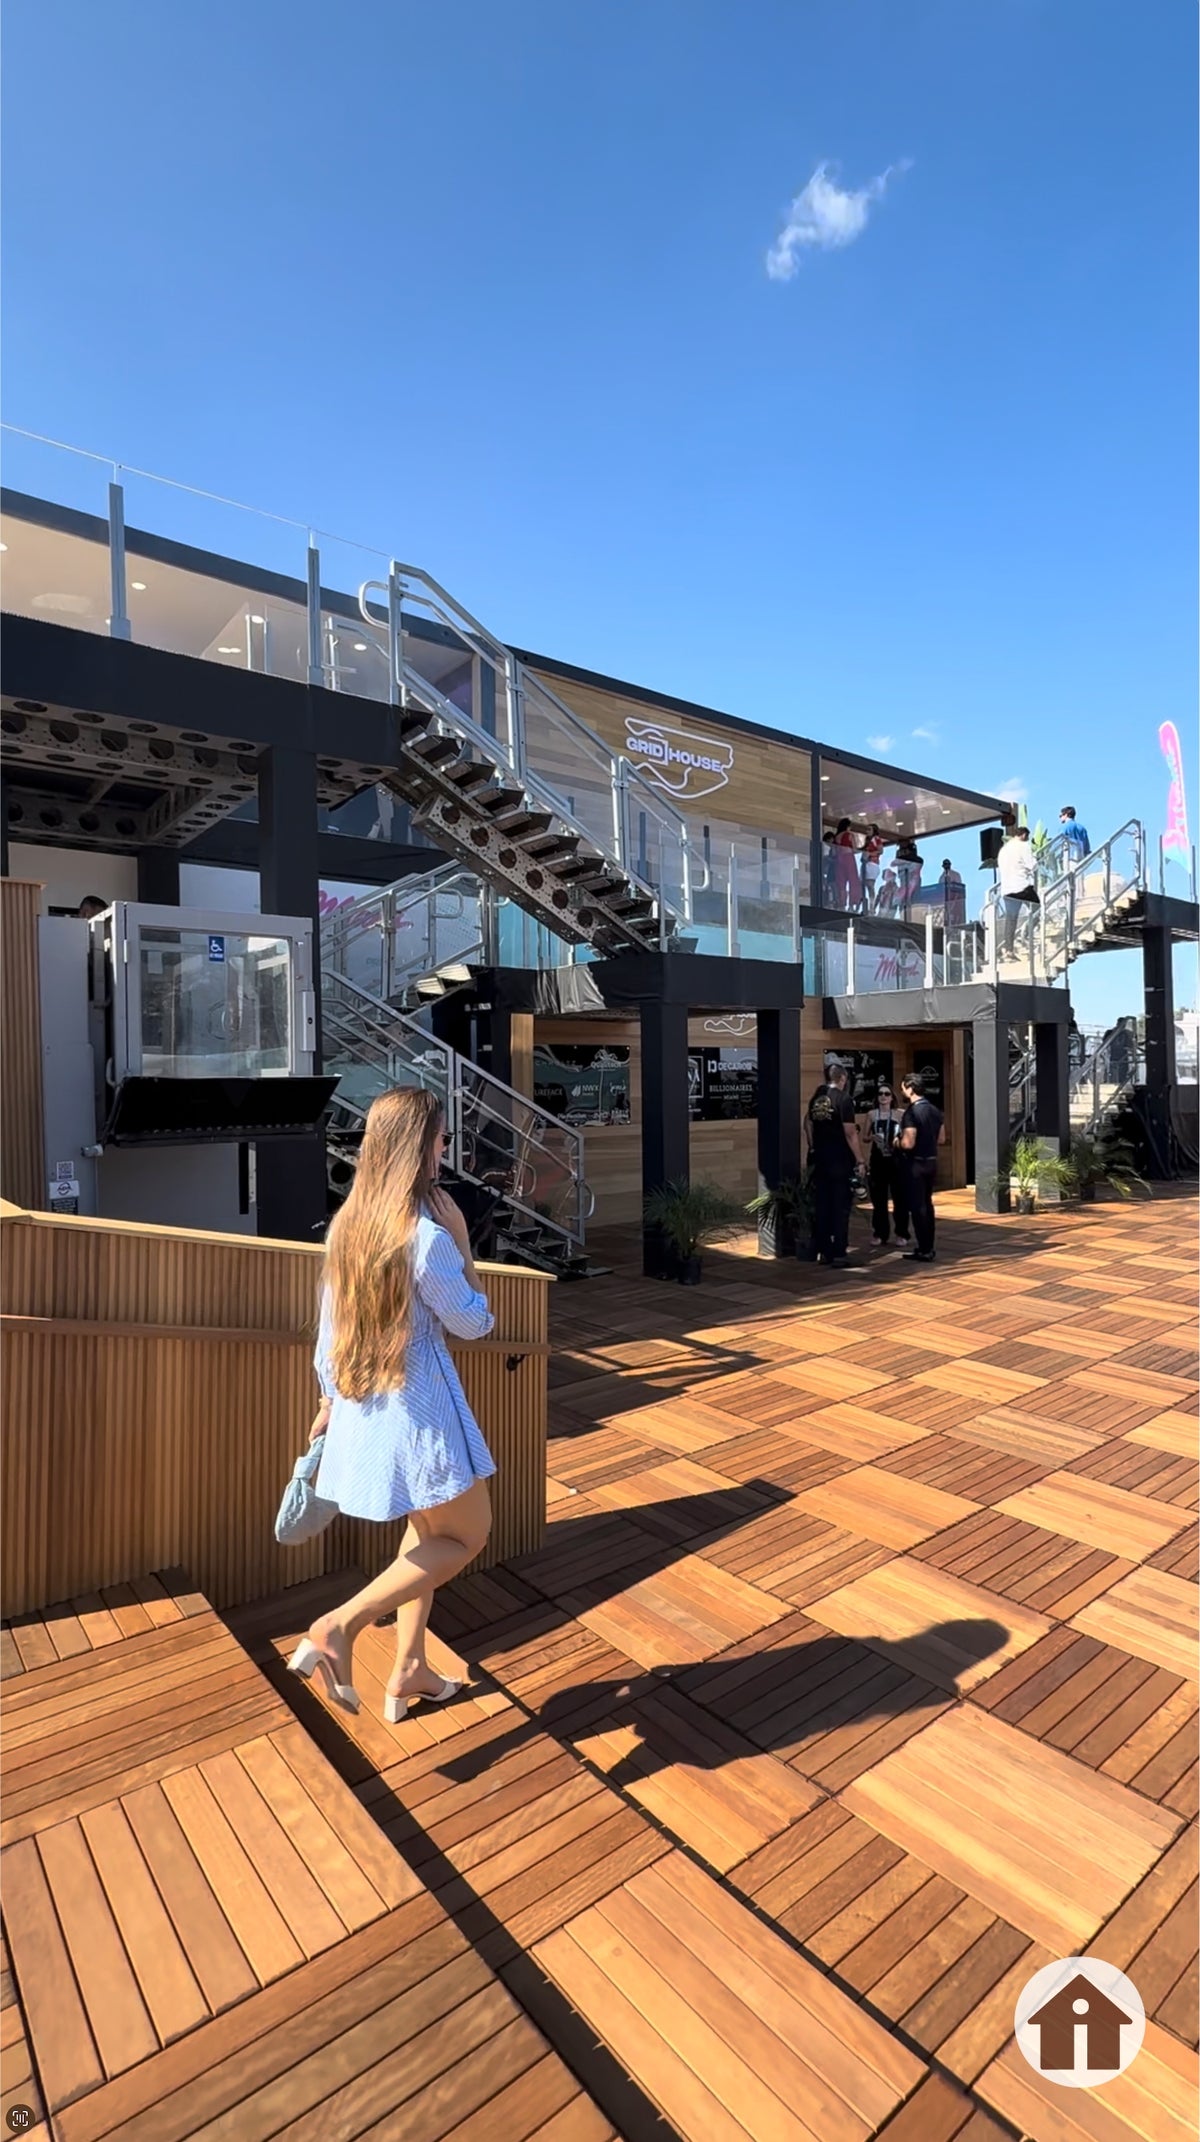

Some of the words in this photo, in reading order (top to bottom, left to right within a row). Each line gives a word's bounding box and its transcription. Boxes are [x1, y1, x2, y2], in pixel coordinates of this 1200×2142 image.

[626, 737, 664, 758] GRID
[668, 748, 723, 773] HOUSE
[709, 1084, 753, 1092] BILLIONAIRES
